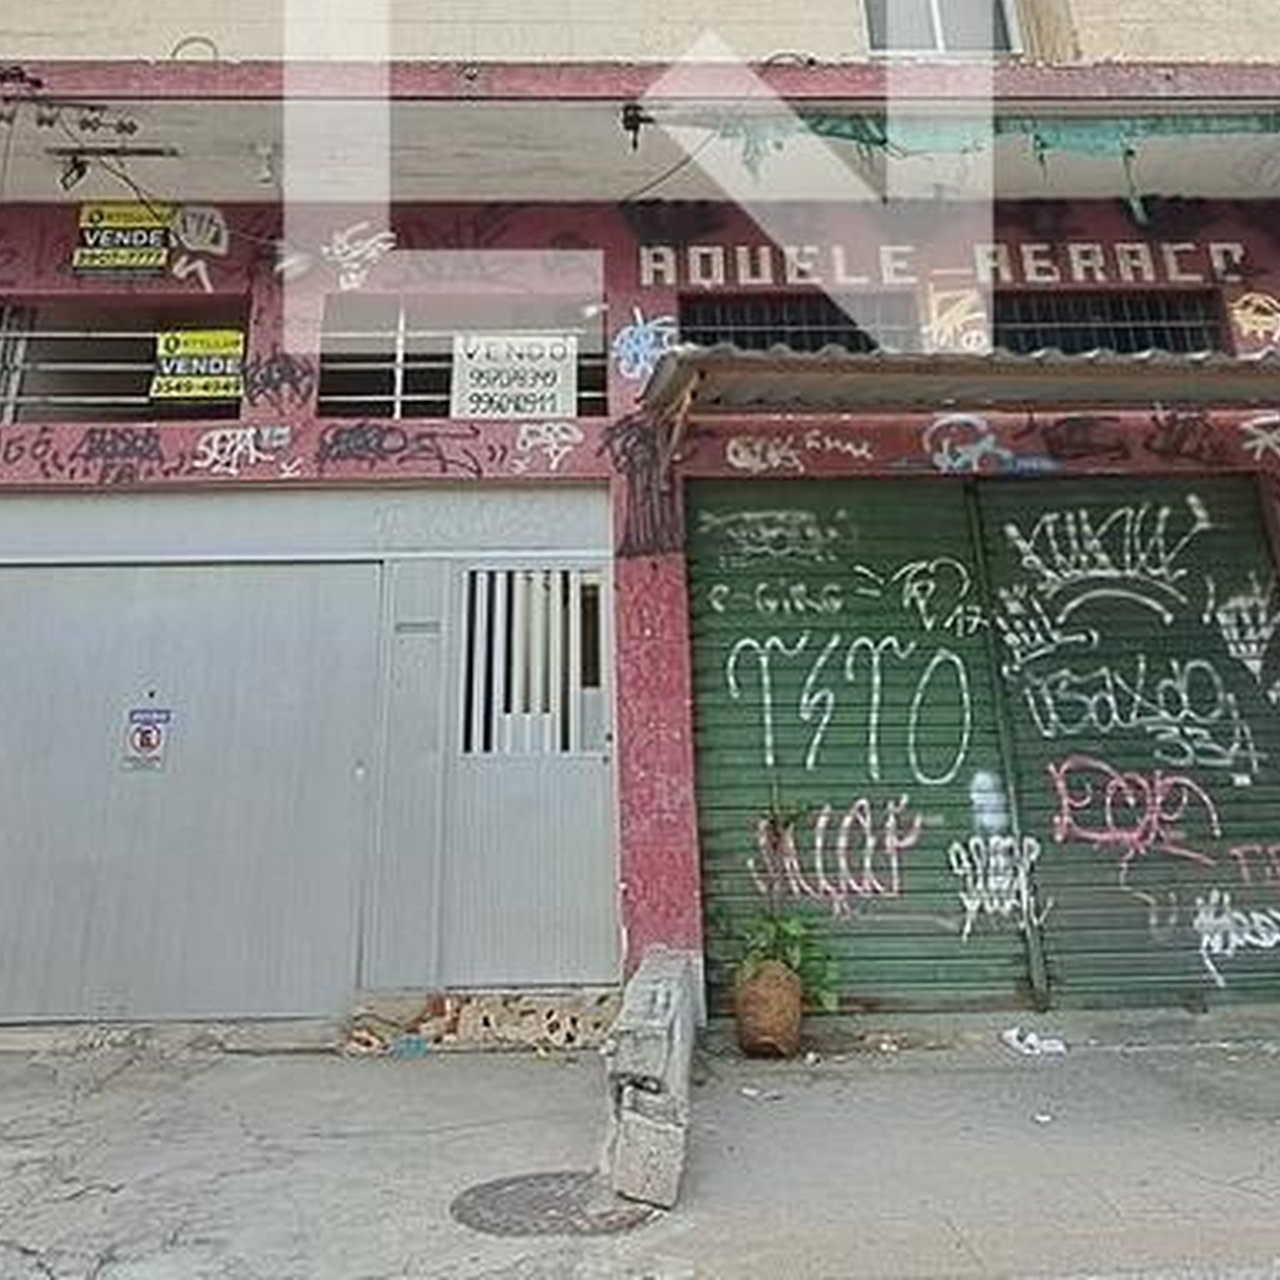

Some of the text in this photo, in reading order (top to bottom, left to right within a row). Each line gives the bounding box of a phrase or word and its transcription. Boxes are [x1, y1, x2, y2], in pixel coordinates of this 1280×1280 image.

[83, 228, 164, 246] VENDE
[639, 245, 919, 288] AQUELE
[463, 342, 568, 362] VENDO
[161, 357, 241, 375] VENDE
